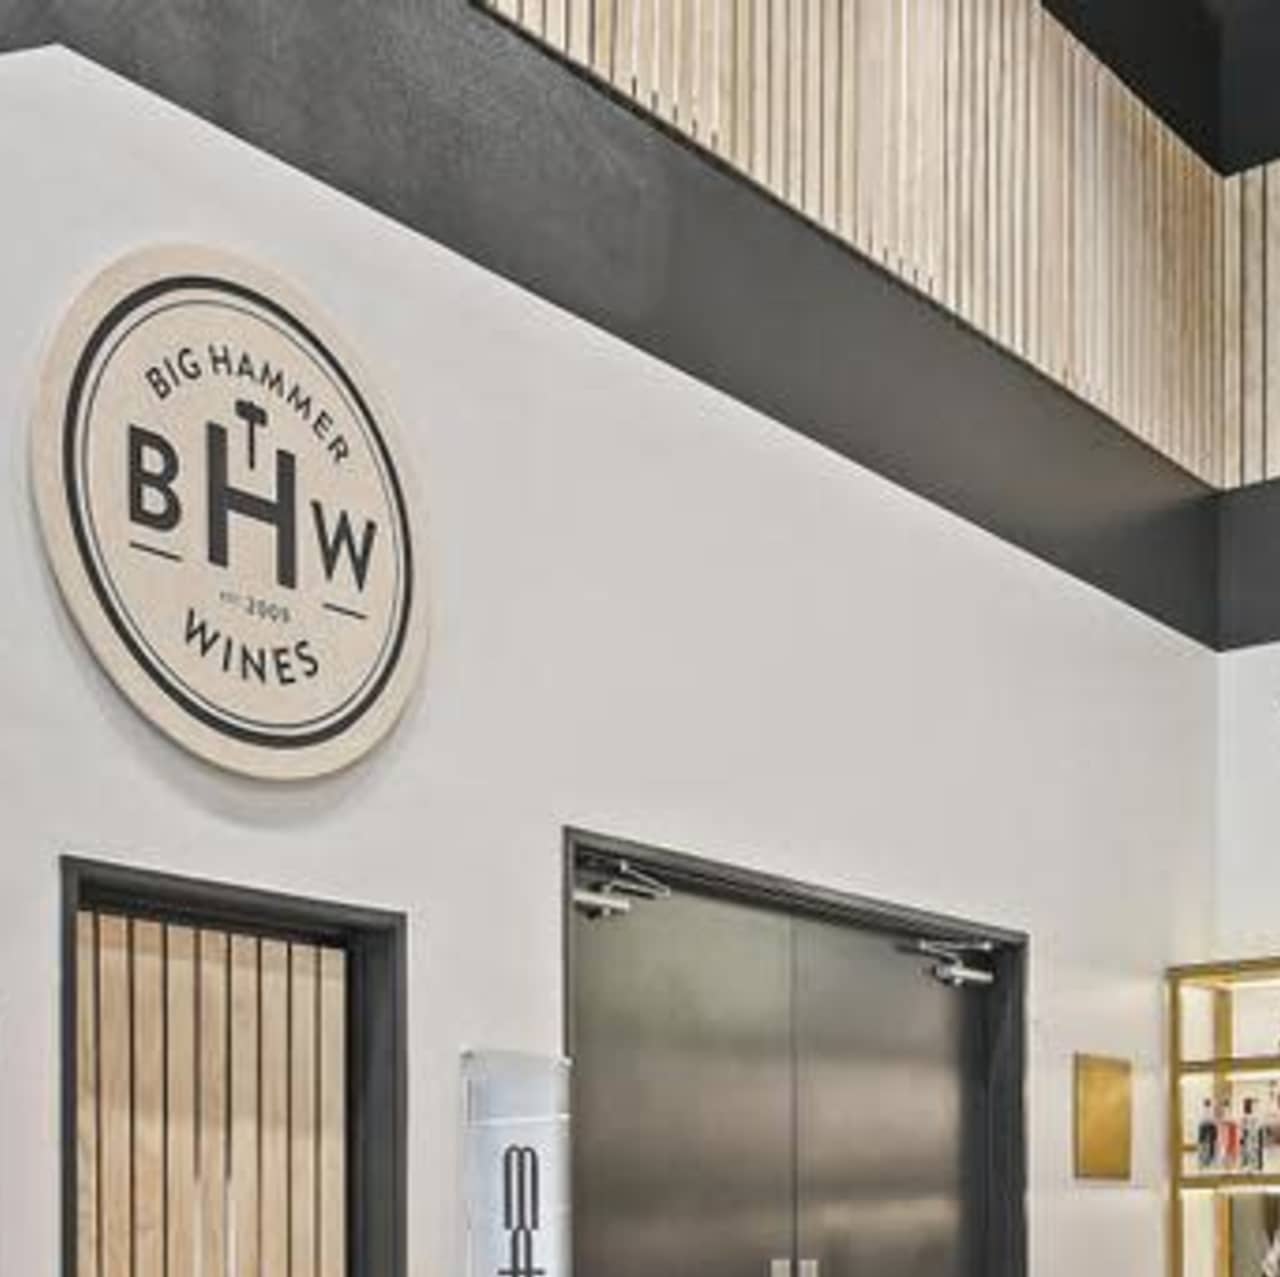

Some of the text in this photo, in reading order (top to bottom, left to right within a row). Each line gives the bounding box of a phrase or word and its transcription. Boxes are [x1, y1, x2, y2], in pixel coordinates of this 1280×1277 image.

[145, 345, 350, 464] BIG HAMMER
[185, 609, 318, 685] WINES
